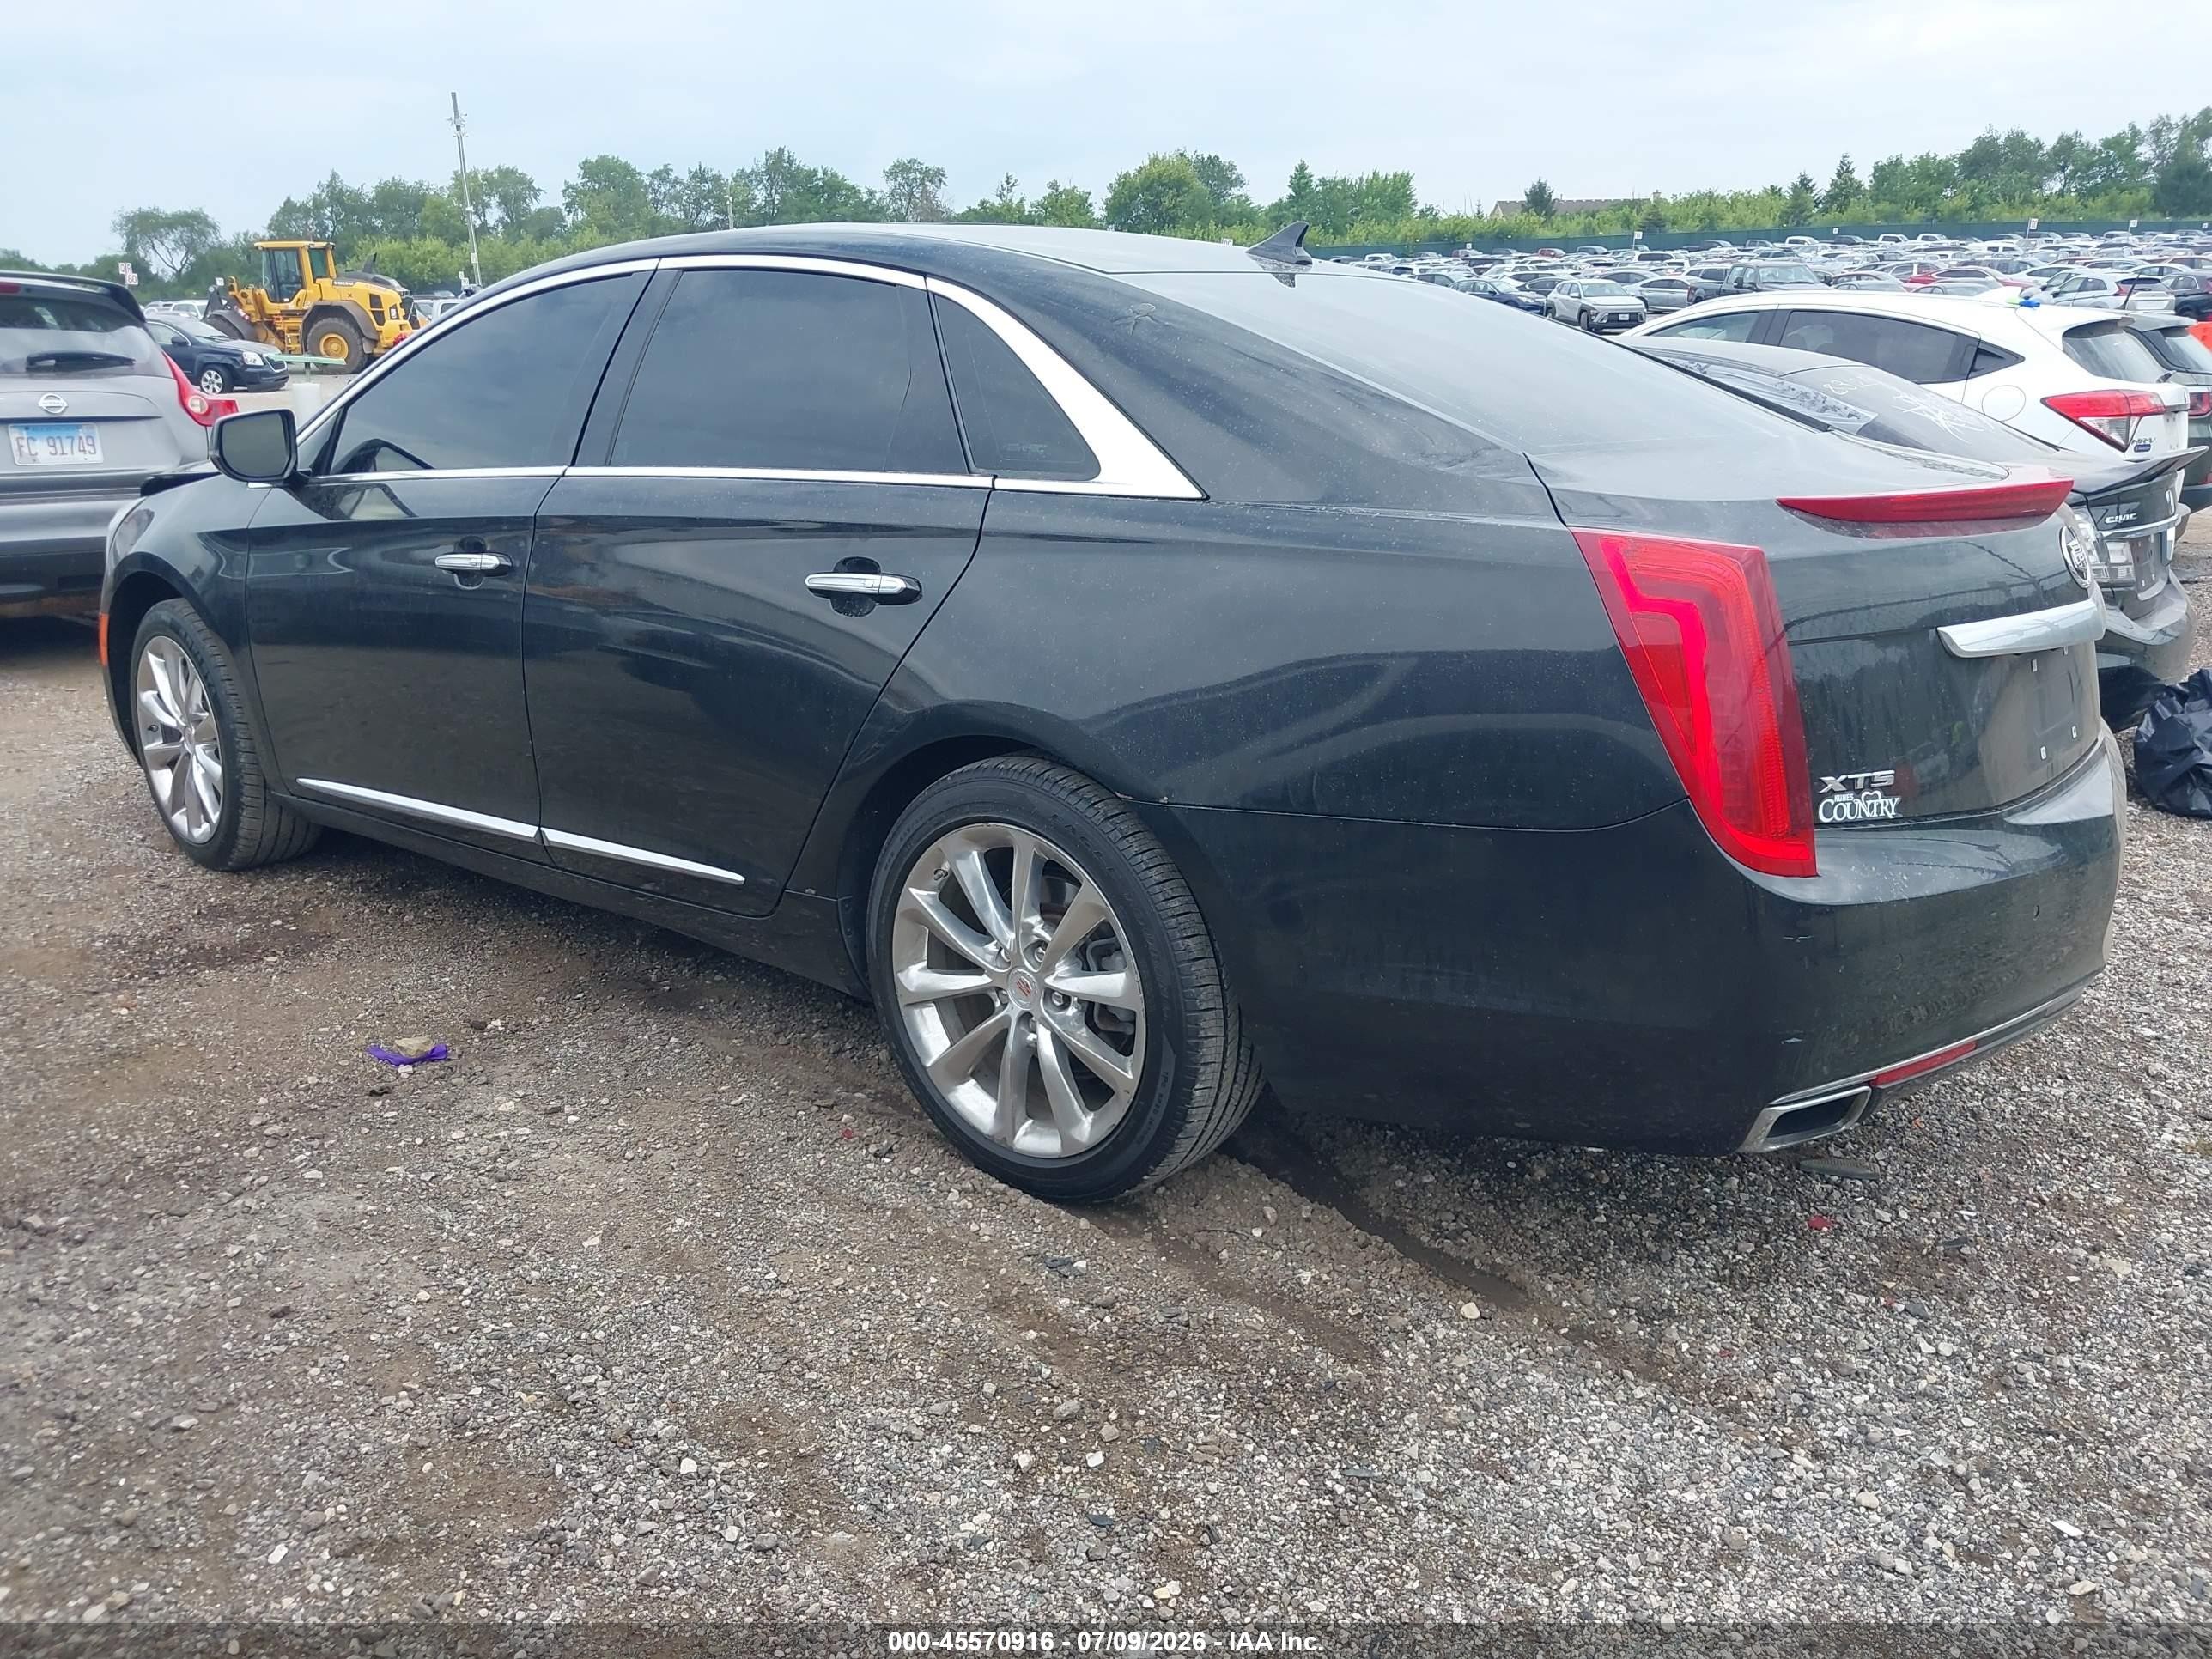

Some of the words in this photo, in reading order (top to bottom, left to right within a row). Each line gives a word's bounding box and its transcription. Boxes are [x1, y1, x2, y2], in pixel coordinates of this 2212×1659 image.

[16, 436, 39, 457] FC
[46, 435, 97, 456] 91749
[2105, 513, 2137, 524] CIVIC
[1819, 769, 1896, 793] XTS
[1818, 790, 1902, 823] COUNTRY
